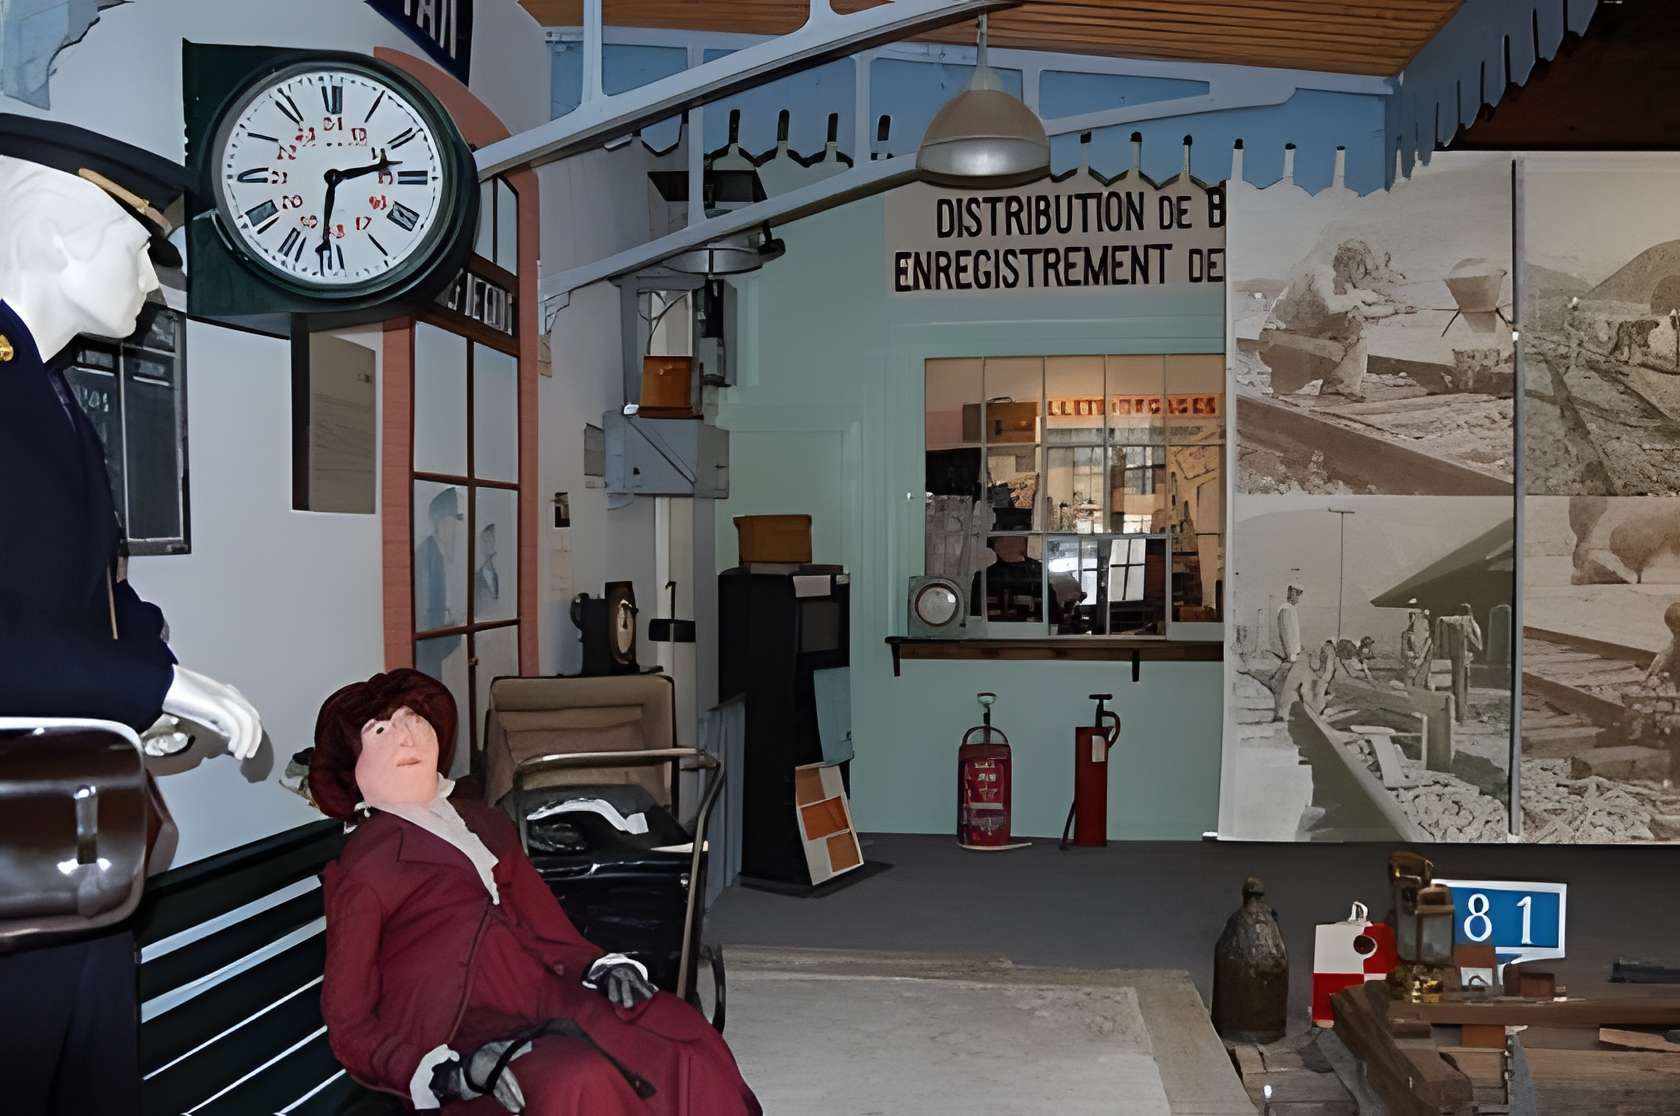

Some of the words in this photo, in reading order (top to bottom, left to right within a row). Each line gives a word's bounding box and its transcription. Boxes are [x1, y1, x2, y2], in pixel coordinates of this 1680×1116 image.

[937, 191, 1145, 238] DISTRIBUTION
[1158, 195, 1193, 230] DE
[895, 243, 1173, 293] ENREGISTREMENT
[1188, 248, 1225, 283] DE
